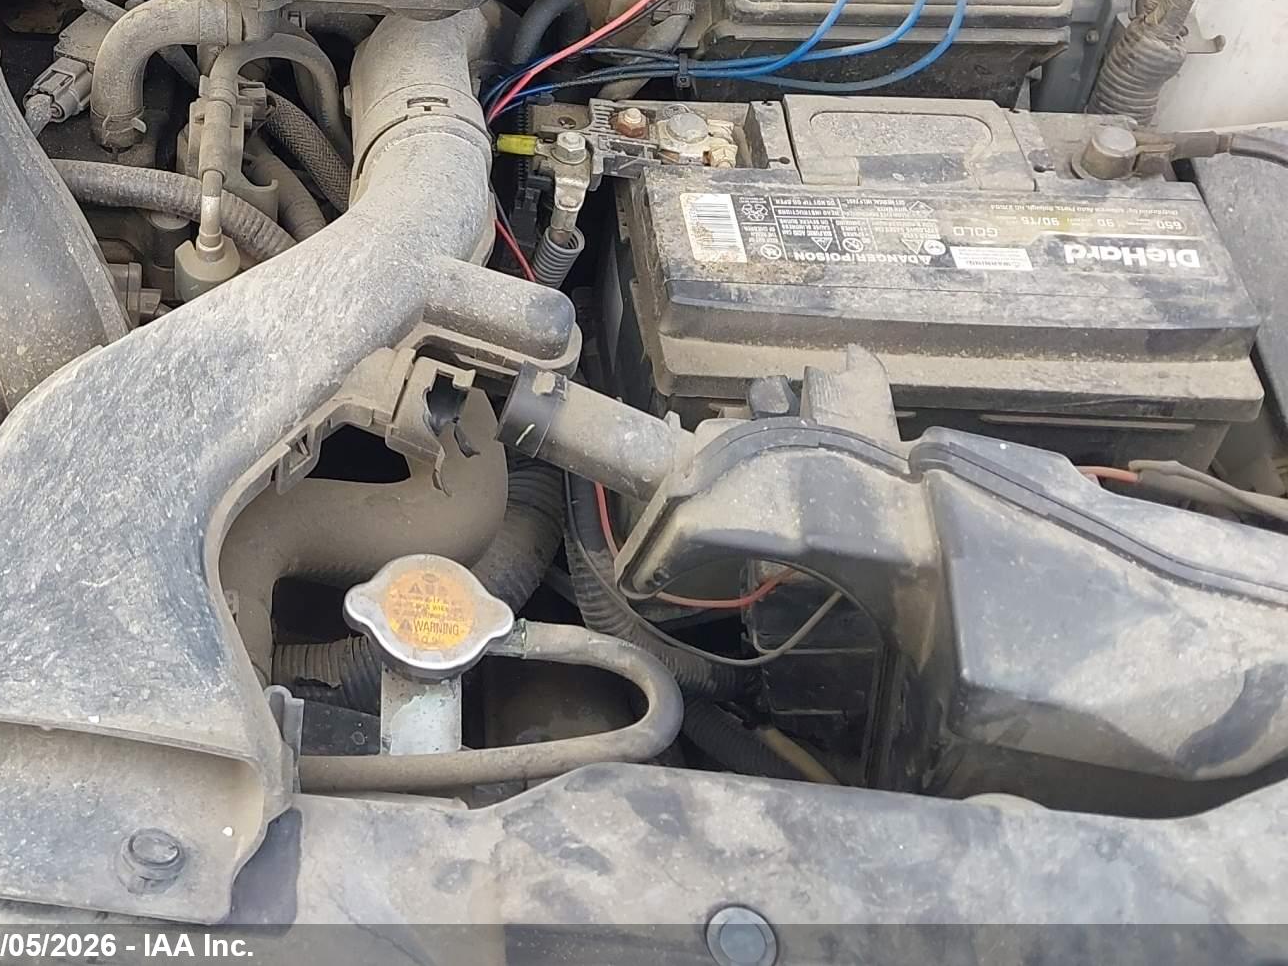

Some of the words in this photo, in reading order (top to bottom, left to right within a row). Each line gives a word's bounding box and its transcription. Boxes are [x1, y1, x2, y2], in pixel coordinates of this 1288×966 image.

[1157, 219, 1183, 230] 650
[953, 225, 999, 237] GOLD
[793, 252, 918, 264] DANGER/POISON
[1063, 244, 1200, 269] DieHard
[414, 619, 460, 636] WARNING
